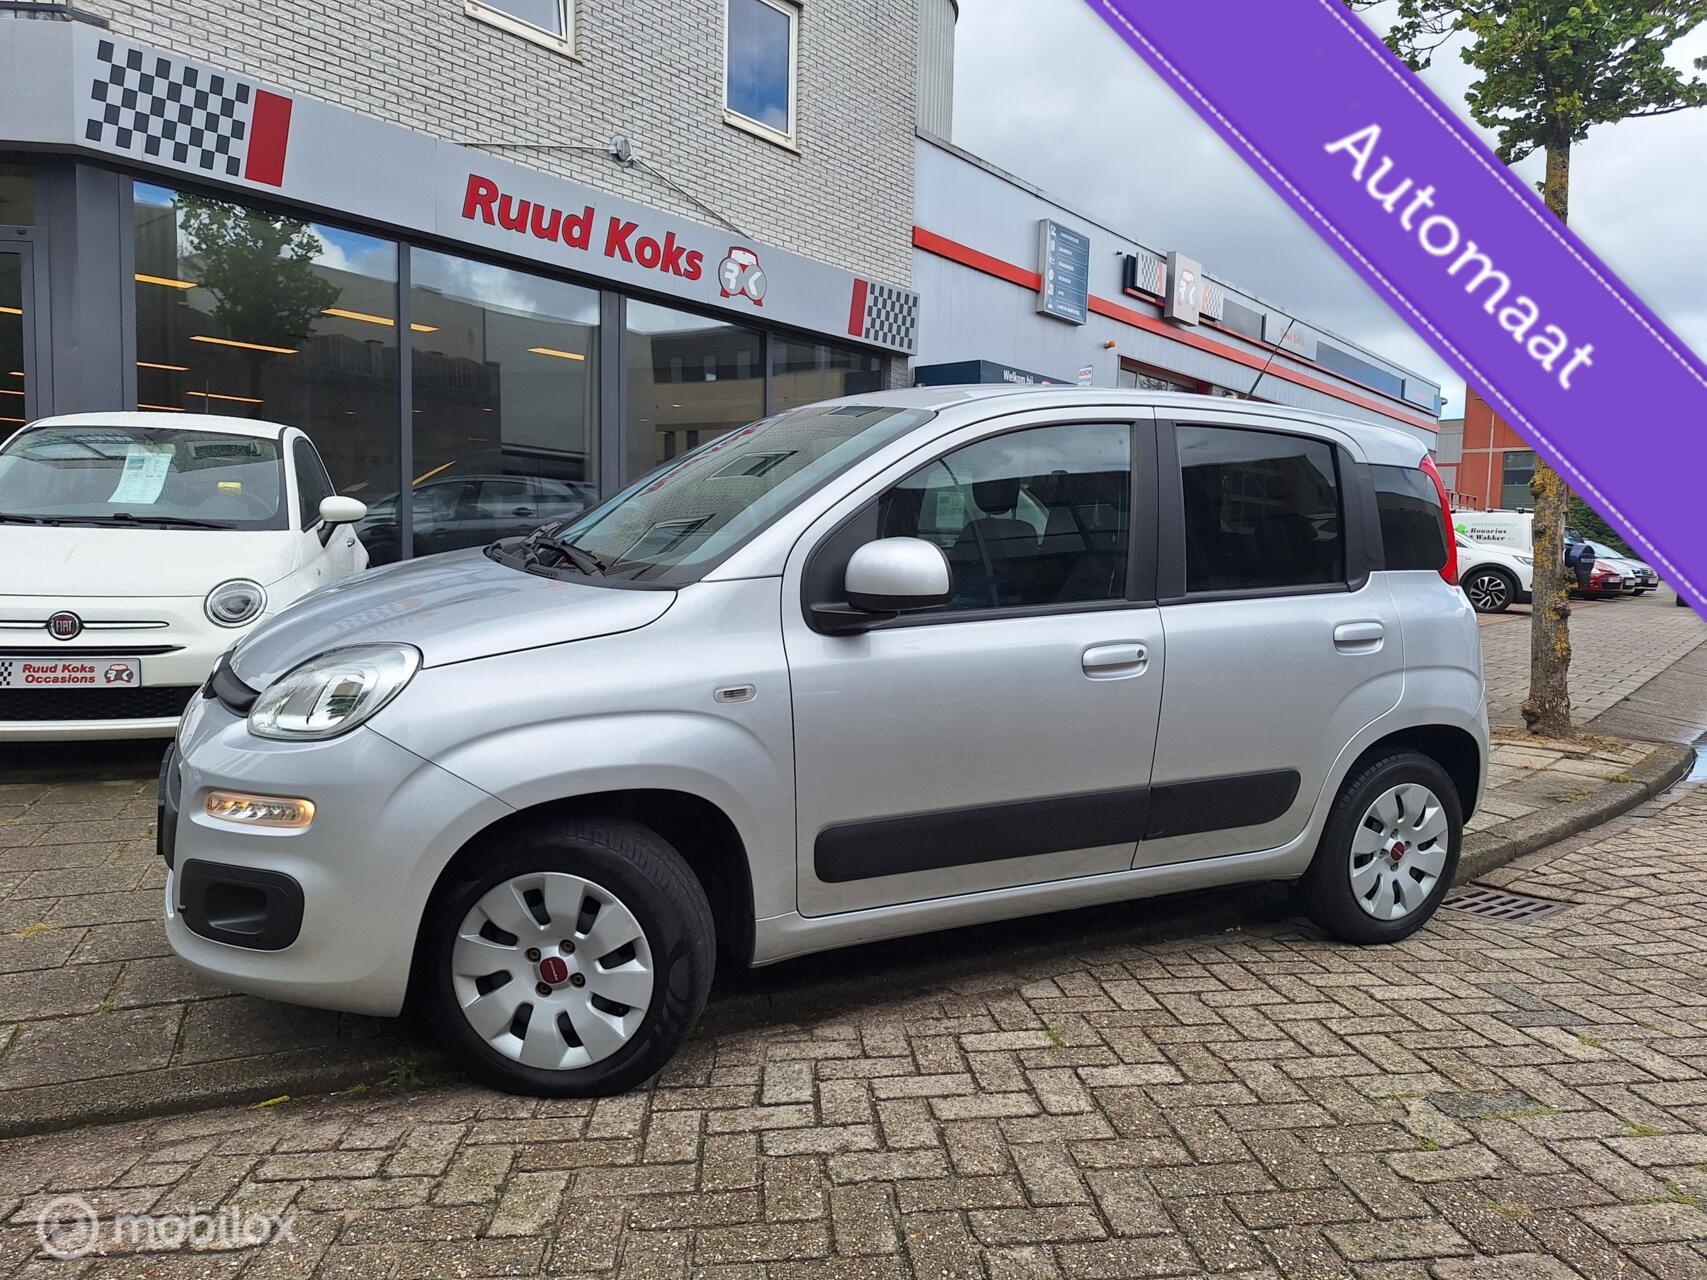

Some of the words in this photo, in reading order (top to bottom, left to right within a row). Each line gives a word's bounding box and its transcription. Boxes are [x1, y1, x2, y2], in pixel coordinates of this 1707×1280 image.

[462, 173, 595, 251] Ruud
[604, 216, 704, 281] Koks
[1003, 369, 1026, 384] Welkom
[55, 620, 73, 632] FIAT
[22, 664, 58, 673] Ruud
[61, 664, 96, 673] Koks
[24, 674, 96, 684] Occasions
